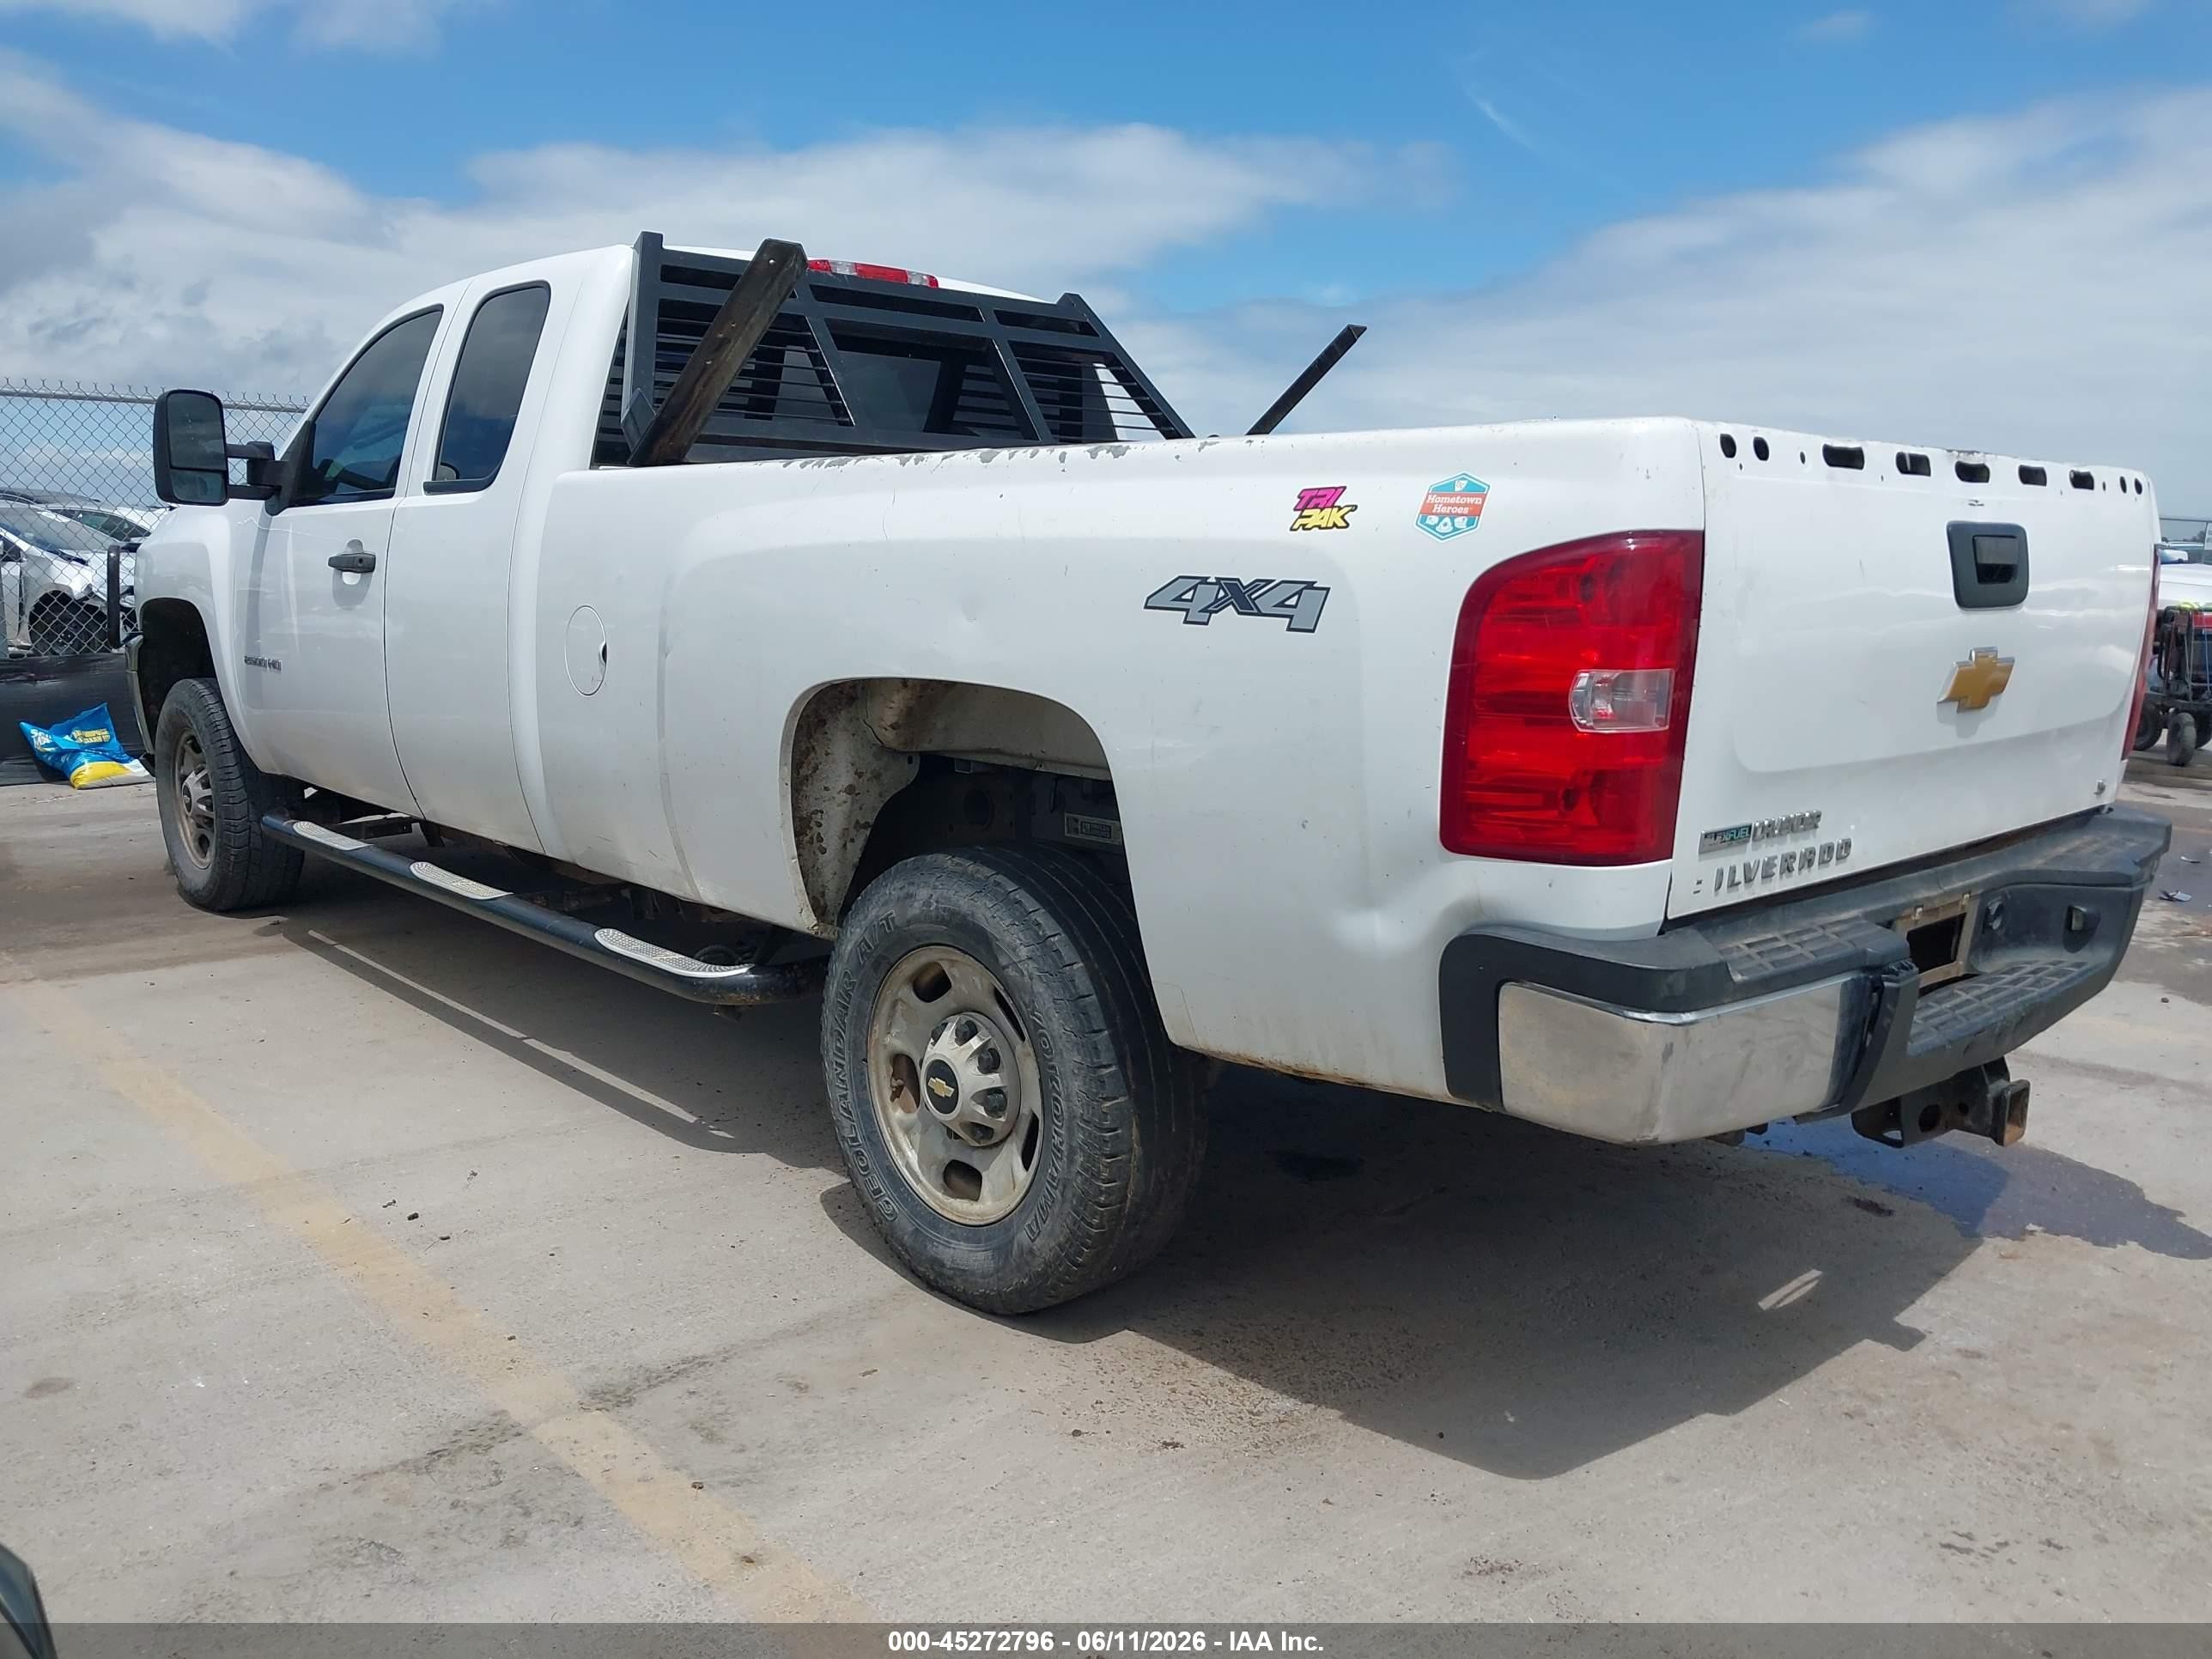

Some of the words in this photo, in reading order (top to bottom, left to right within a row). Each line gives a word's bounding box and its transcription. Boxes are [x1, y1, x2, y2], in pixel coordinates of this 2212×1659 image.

[1293, 486, 1346, 511] TRI
[1425, 494, 1483, 505] Hometown
[1431, 503, 1470, 514] Heroes
[1290, 505, 1358, 531] PAK
[1693, 837, 1852, 895] ILVERADO
[858, 908, 896, 964] A/T
